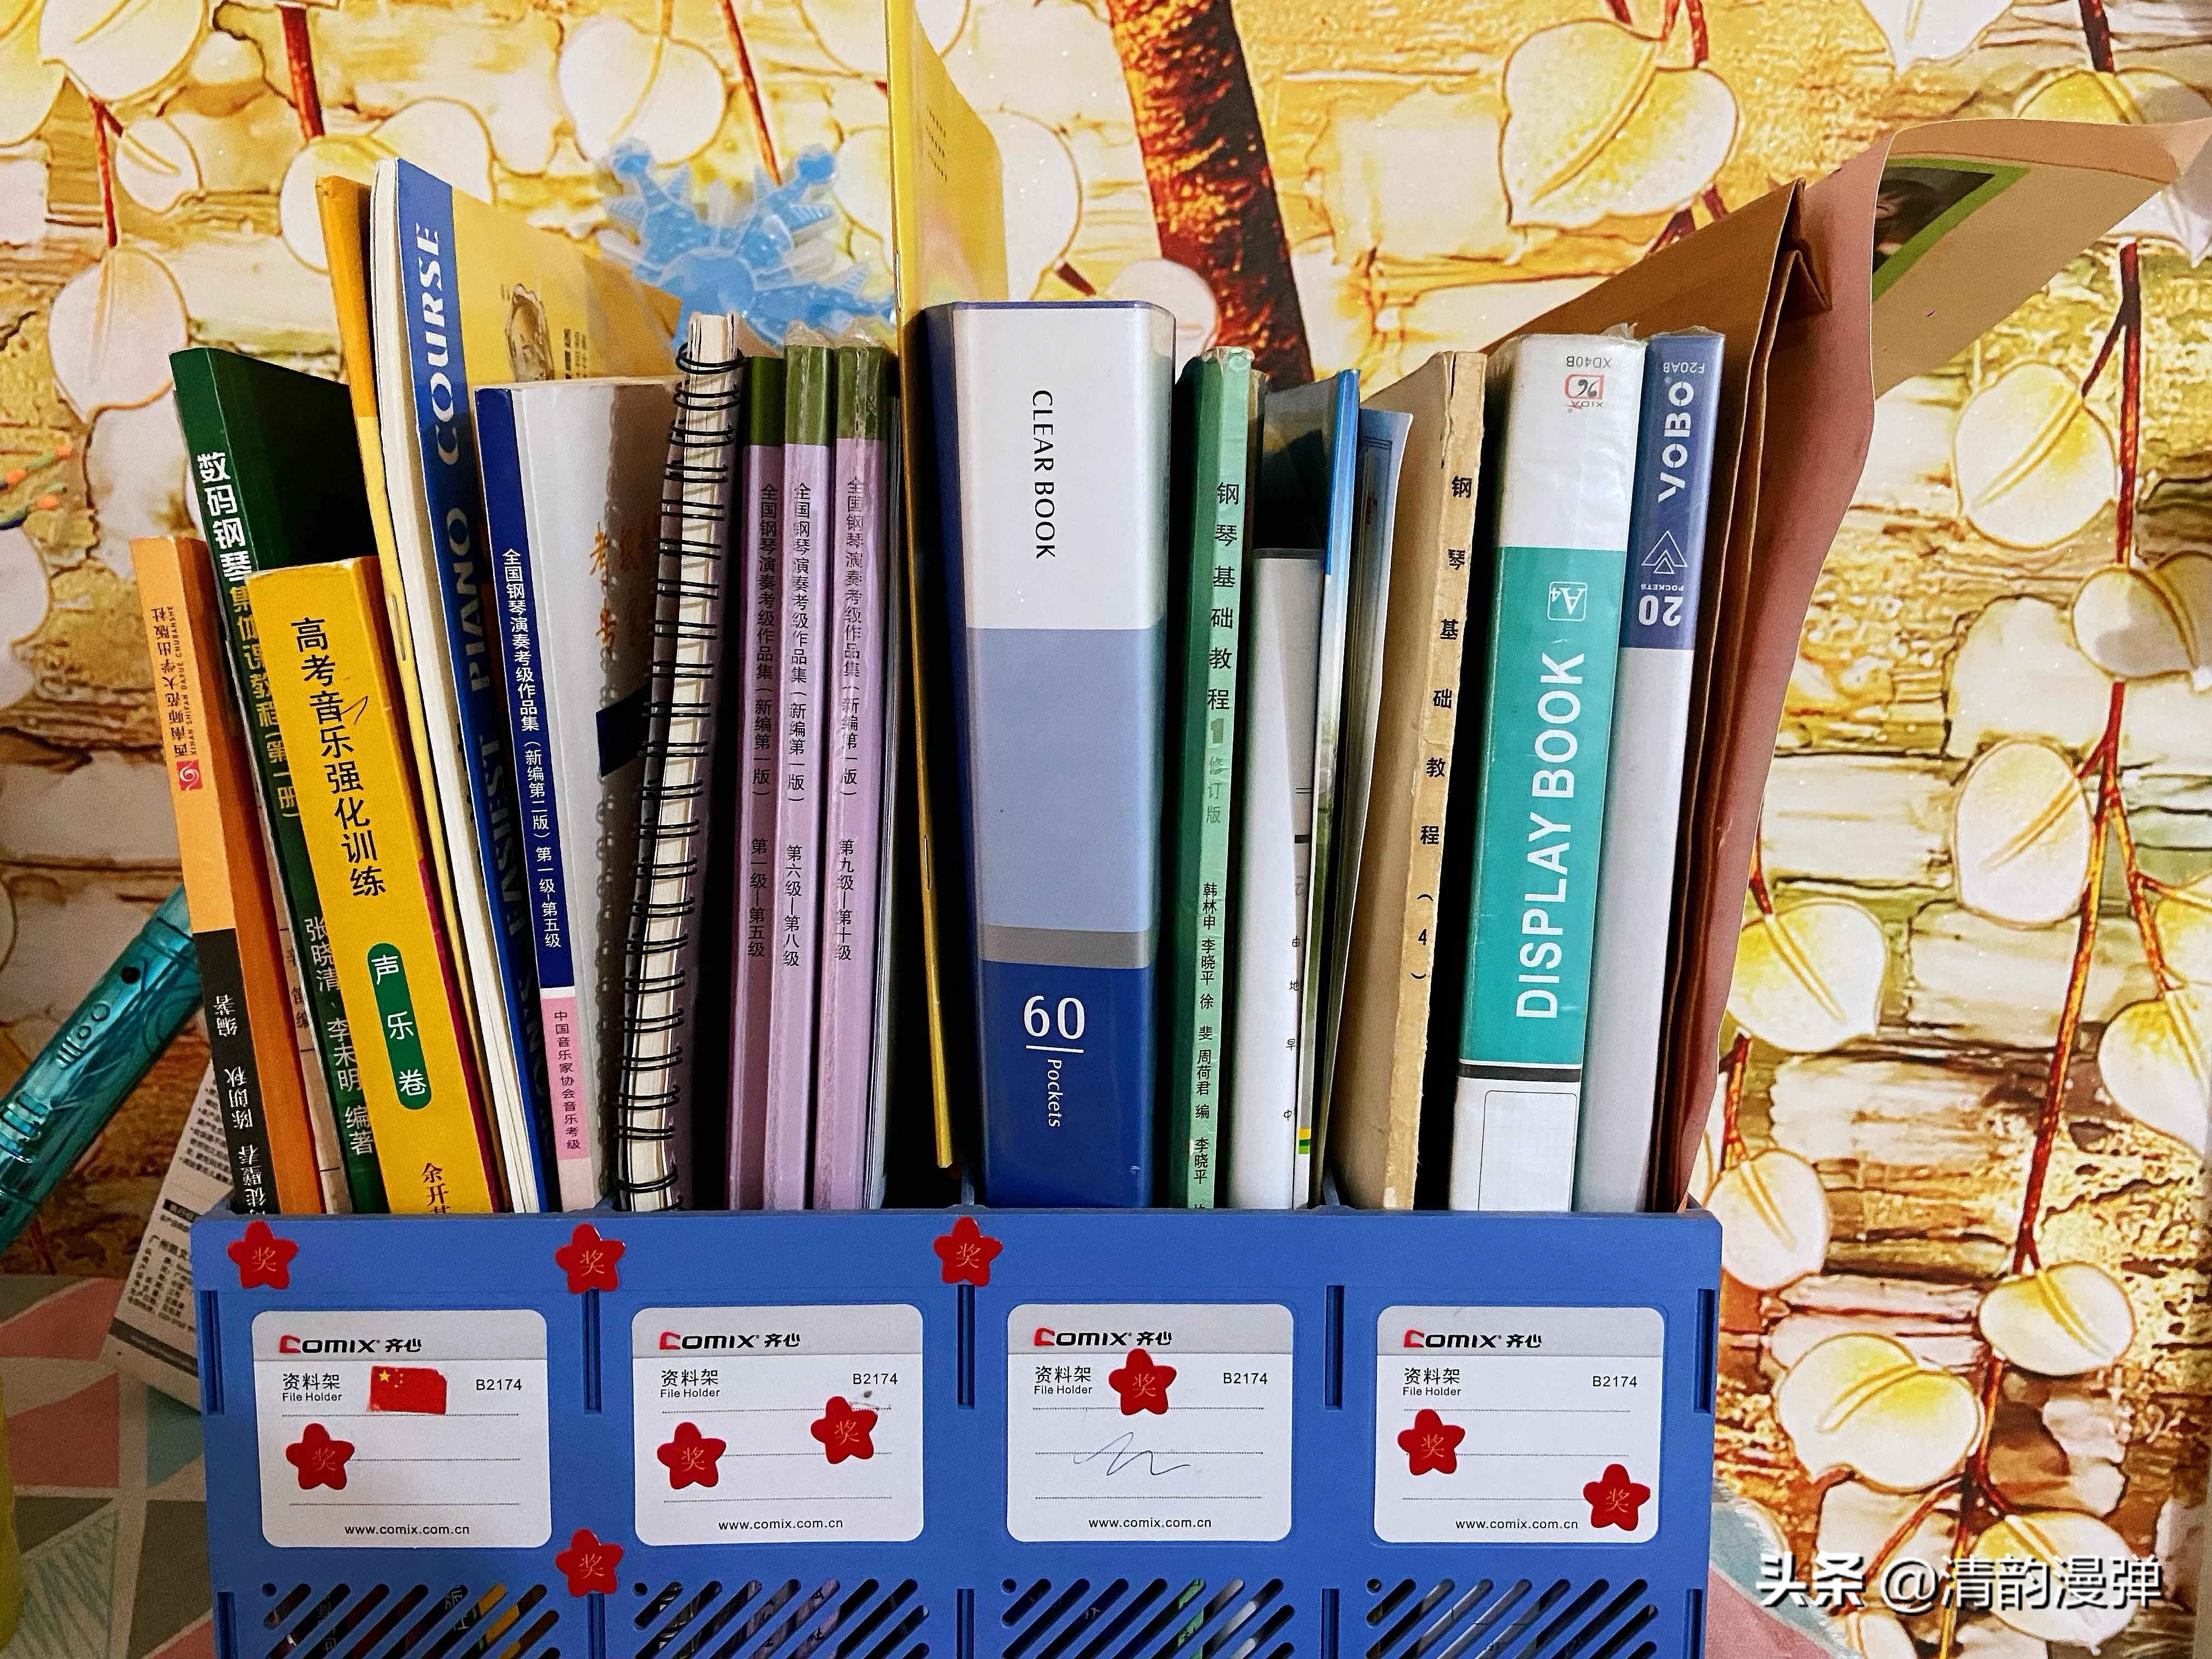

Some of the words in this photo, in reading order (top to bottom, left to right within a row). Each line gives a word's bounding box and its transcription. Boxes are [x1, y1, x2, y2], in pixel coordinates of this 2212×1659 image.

[415, 222, 460, 465] COURSE
[1566, 356, 1611, 369] XD40B
[1663, 363, 1705, 374] F20AB
[1032, 390, 1054, 472] CLEAR
[1657, 381, 1695, 503] YOBO
[1034, 482, 1056, 559] BOOK
[446, 508, 491, 692] PIANO
[1207, 482, 1240, 711] 钢琴基础教程
[1550, 588, 1587, 615] A4
[1638, 596, 1683, 627] 20
[151, 607, 187, 757] 西南师范大学出版社
[1531, 652, 1584, 799] BOOK
[291, 617, 386, 897] 高考音乐强化训练
[1206, 756, 1226, 824] 修订版
[1202, 882, 1217, 931] 韩林申
[1516, 812, 1571, 1019] DISPLAY
[1200, 938, 1216, 986] 李晓平
[213, 994, 239, 1037] 编著
[371, 954, 428, 1096] 声乐卷
[1024, 995, 1085, 1040] 60
[554, 1011, 581, 1150] 中国音乐家协会音乐考级
[1196, 1049, 1211, 1096] 周荷君
[1047, 1059, 1064, 1127] Pockets
[1195, 1104, 1210, 1119] 编
[1193, 1137, 1209, 1184] 李晓平
[238, 1144, 267, 1215] 徒璧春
[252, 1248, 276, 1272] 奖
[580, 1250, 605, 1274] 奖
[956, 1243, 981, 1268] 奖
[385, 1338, 422, 1353] 齐心
[764, 1333, 800, 1348] 齐心
[1136, 1331, 1172, 1346] 齐心
[1506, 1334, 1542, 1348] 齐心
[283, 1373, 341, 1391] 资料架
[476, 1379, 522, 1391] B2174
[661, 1369, 719, 1386] 资料架
[853, 1373, 898, 1385] B2174
[1035, 1365, 1091, 1383] 资料架
[1132, 1373, 1156, 1398] 奖
[1223, 1373, 1268, 1385] B2174
[1404, 1367, 1460, 1385] 资料架
[1593, 1375, 1638, 1387] B2174
[283, 1392, 302, 1401] File
[304, 1392, 342, 1402] Holder
[661, 1389, 680, 1398] File
[684, 1388, 720, 1397] Holder
[1034, 1385, 1053, 1395] File
[1057, 1385, 1092, 1395] Holder
[1403, 1387, 1422, 1396] File
[1425, 1387, 1461, 1396] Holder
[834, 1420, 860, 1446] 奖
[312, 1447, 337, 1471] 奖
[1421, 1434, 1445, 1459] 奖
[681, 1448, 705, 1472] 奖
[1605, 1488, 1629, 1514] 奖
[345, 1525, 470, 1535] www.comix.com.cn
[719, 1518, 843, 1530] www.comix.com.cn
[1088, 1517, 1211, 1528] www.comix.com.cn
[1455, 1519, 1578, 1530] www.comix.com.cn
[579, 1553, 605, 1579] 奖
